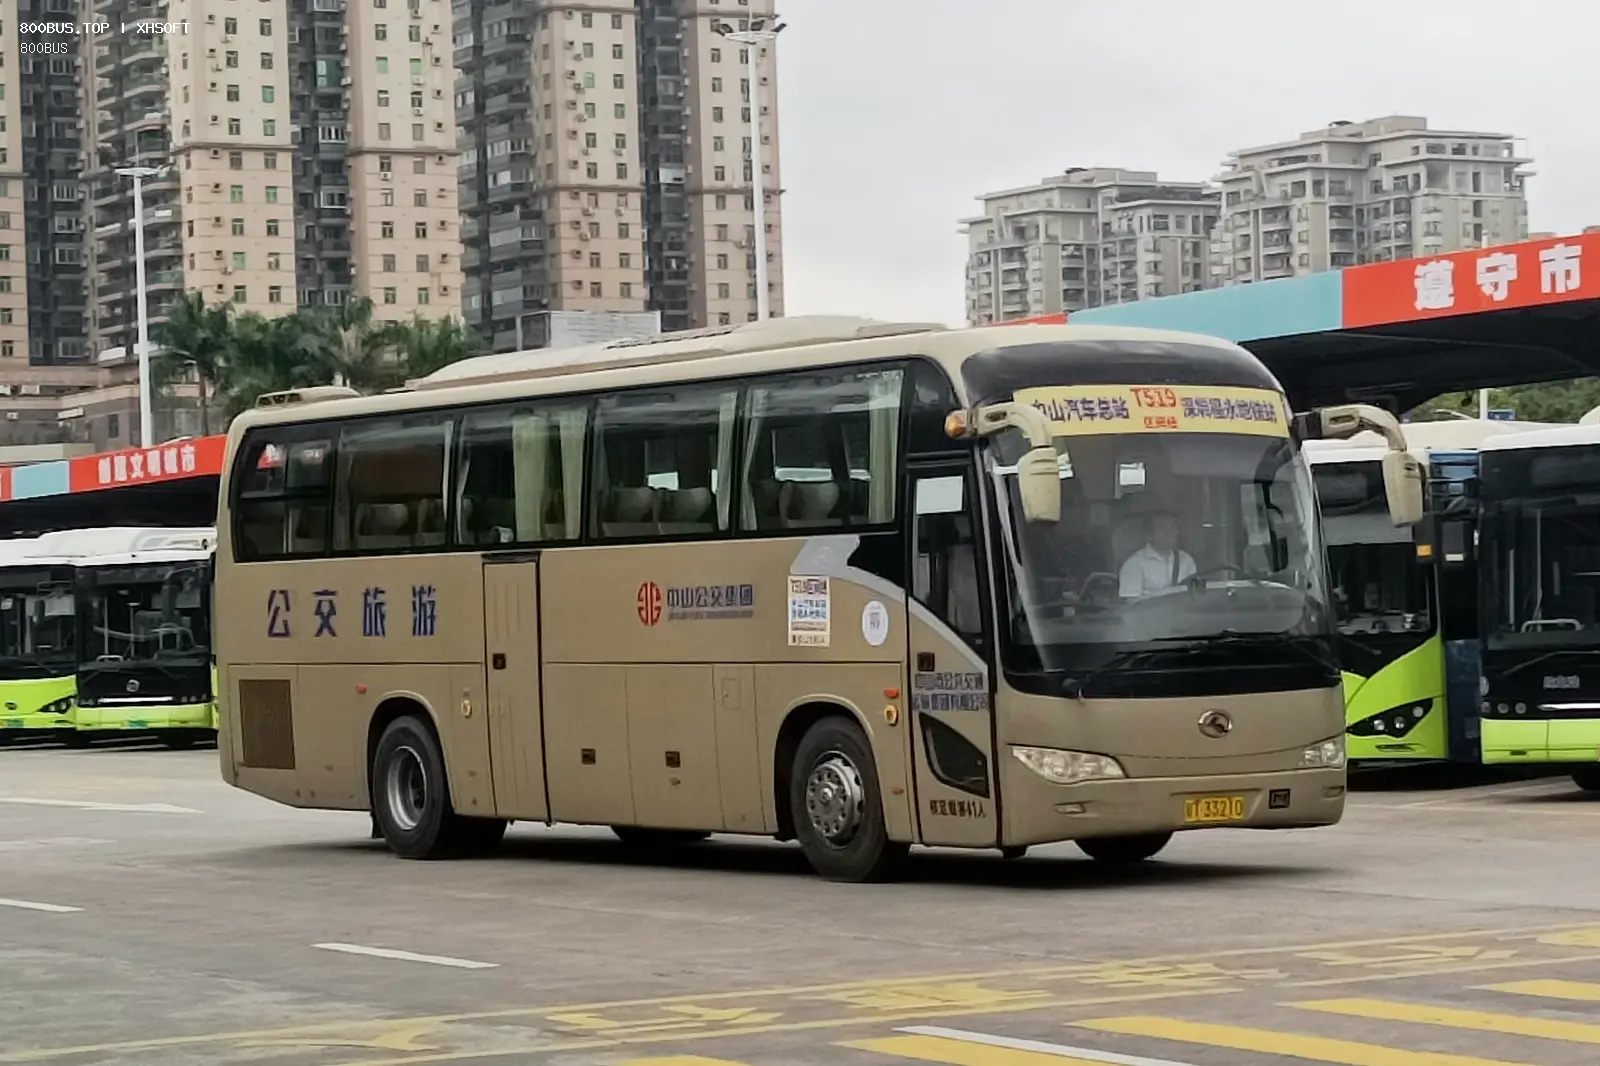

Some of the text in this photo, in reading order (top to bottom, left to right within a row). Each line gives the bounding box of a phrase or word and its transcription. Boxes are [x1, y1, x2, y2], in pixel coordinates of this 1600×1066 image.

[1130, 388, 1177, 408] T519
[667, 584, 754, 609] 中山公交集团
[267, 584, 437, 638] 公交旅游
